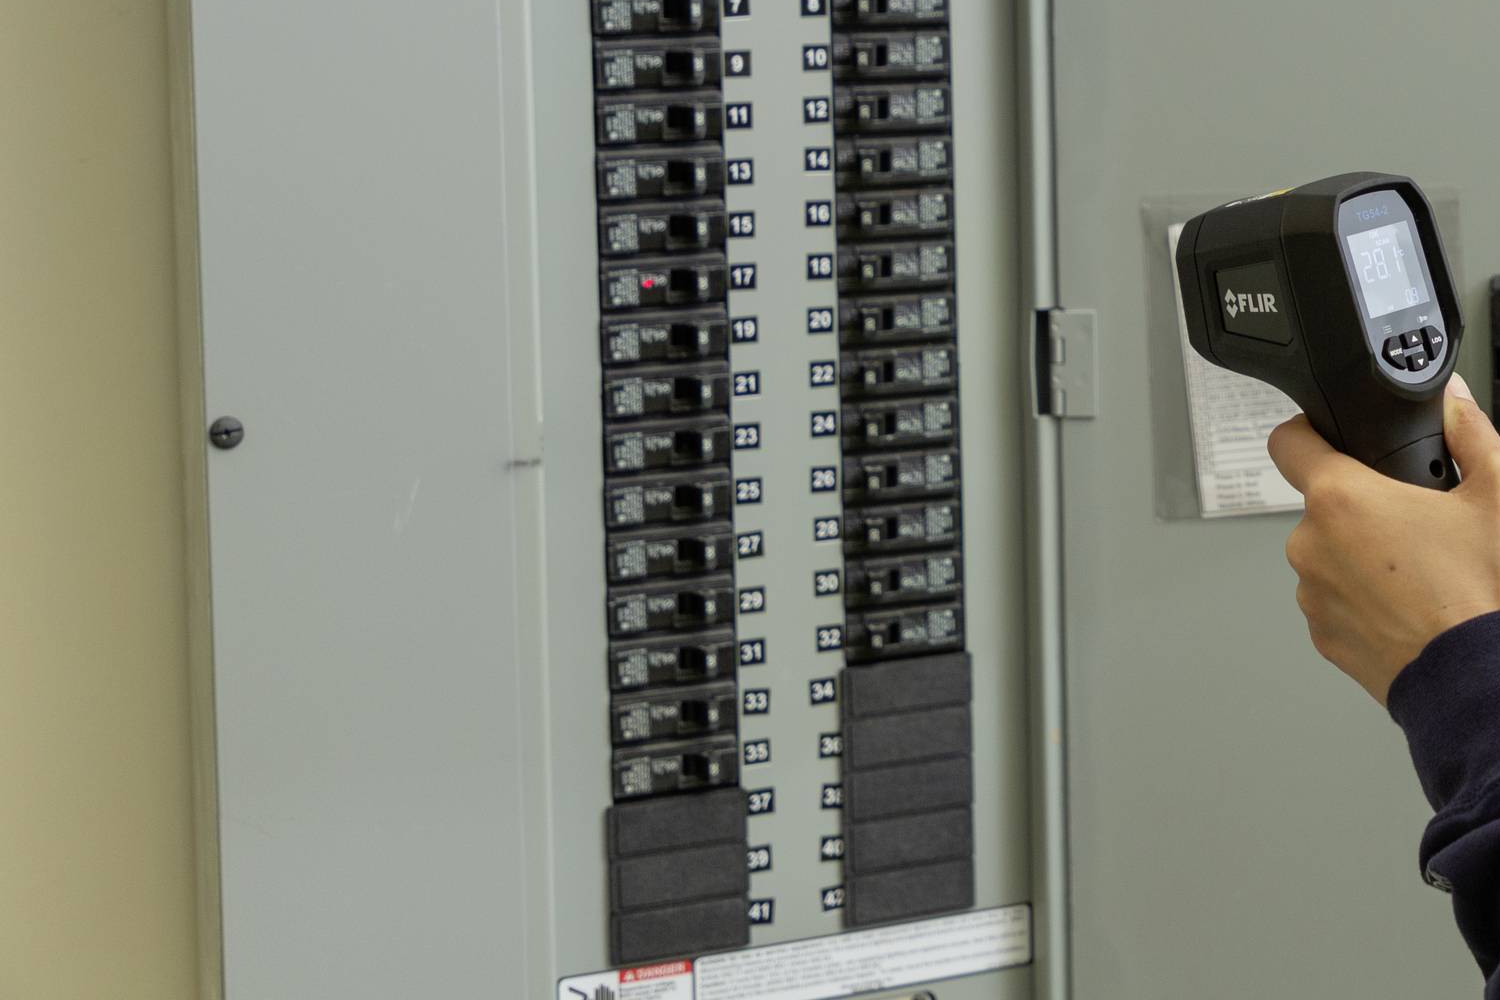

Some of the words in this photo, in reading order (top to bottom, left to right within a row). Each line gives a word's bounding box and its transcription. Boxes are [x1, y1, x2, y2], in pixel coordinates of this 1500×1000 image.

[731, 55, 744, 73] 9
[806, 48, 827, 66] 10
[729, 106, 747, 124] 11
[806, 100, 827, 118] 12
[808, 151, 829, 168] 14
[729, 162, 751, 180] 13
[808, 205, 830, 222] 16
[731, 216, 753, 233] 15
[810, 257, 831, 275] 18
[732, 267, 754, 285] 17
[1237, 293, 1278, 312] FLIR
[809, 311, 832, 328] 20
[734, 320, 755, 338] 19
[1431, 336, 1442, 344] LOG
[1390, 347, 1403, 357] MODE
[812, 365, 834, 383] 22
[736, 375, 756, 393] 21
[813, 415, 835, 433] 24
[736, 427, 758, 445] 23
[813, 470, 835, 488] 26
[737, 482, 760, 500] 25
[816, 520, 838, 538] 28
[739, 535, 760, 554] 27
[817, 574, 838, 592] 30
[740, 591, 763, 610] 29
[819, 629, 840, 647] 32
[741, 643, 761, 661] 31
[812, 681, 834, 700] 34
[745, 693, 767, 710] 33
[746, 743, 768, 761] 35
[749, 791, 772, 812] 37
[747, 849, 770, 869] 39
[748, 902, 770, 920] 41
